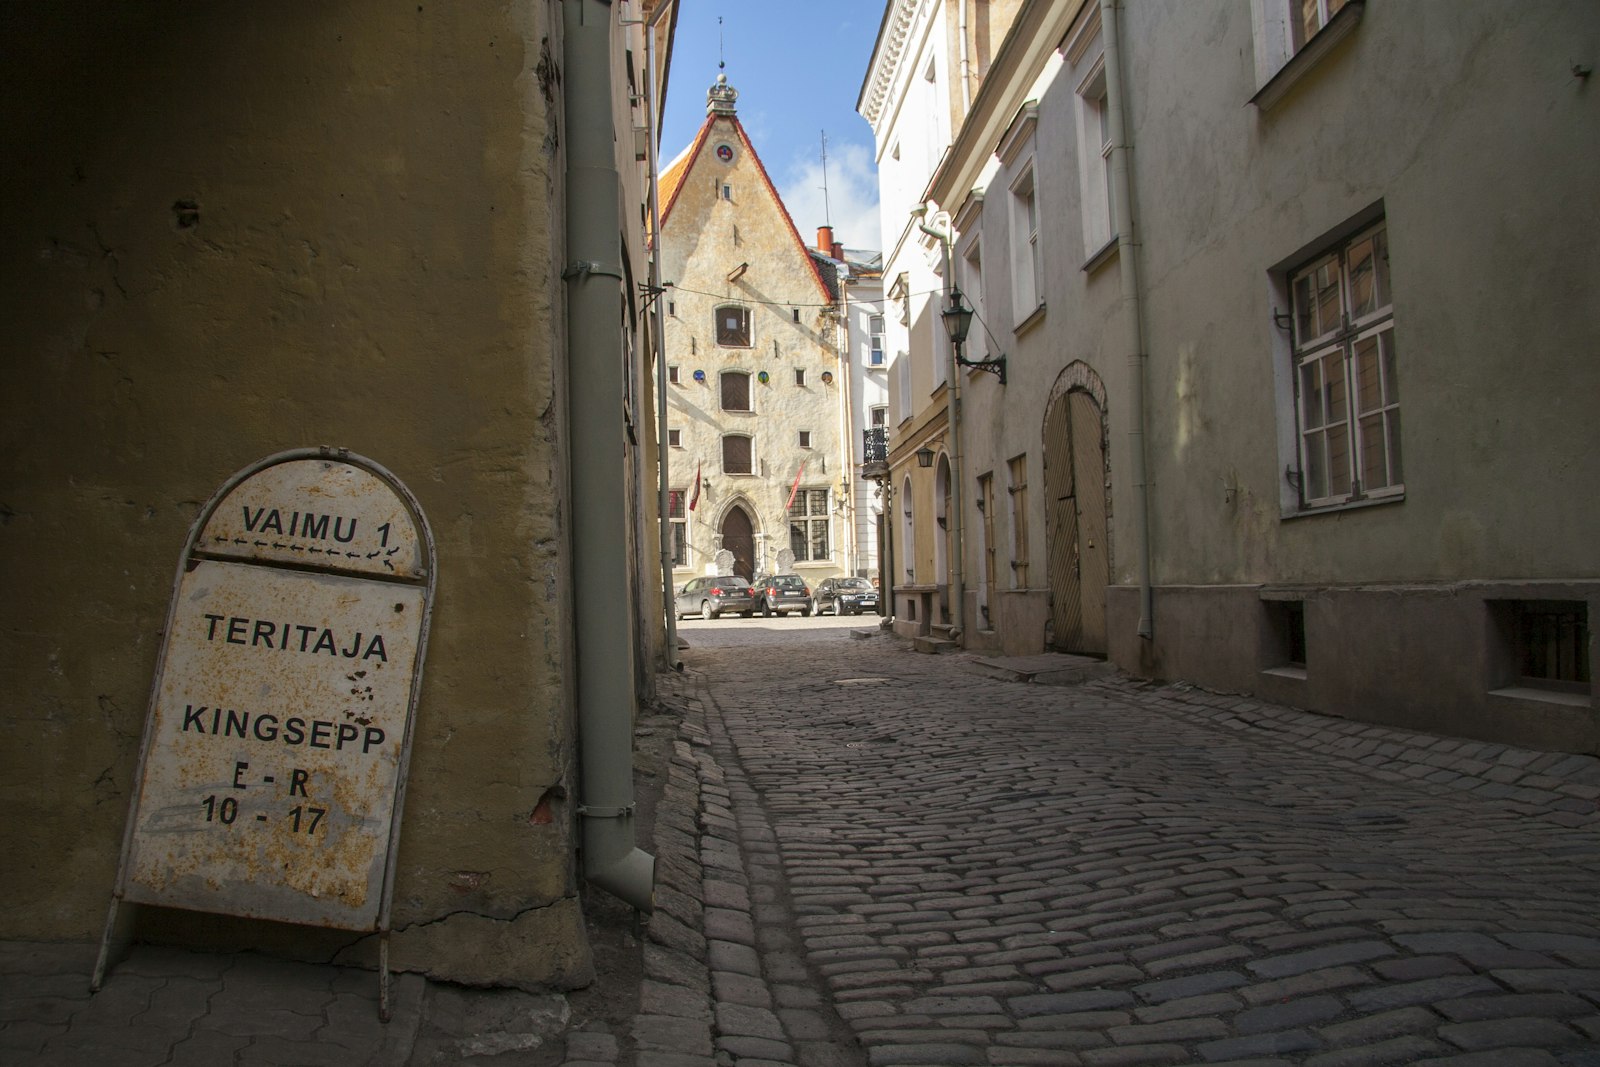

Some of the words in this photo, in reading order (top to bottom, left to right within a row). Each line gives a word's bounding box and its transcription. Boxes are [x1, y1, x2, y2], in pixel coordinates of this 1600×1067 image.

[243, 506, 357, 543] VAIMU
[377, 522, 391, 548] 1
[204, 613, 388, 662] TERITAJA
[182, 704, 386, 754] KINGSEPP
[233, 761, 249, 790] E
[289, 768, 309, 798] R
[202, 794, 238, 825] 10
[289, 805, 326, 835] 17
